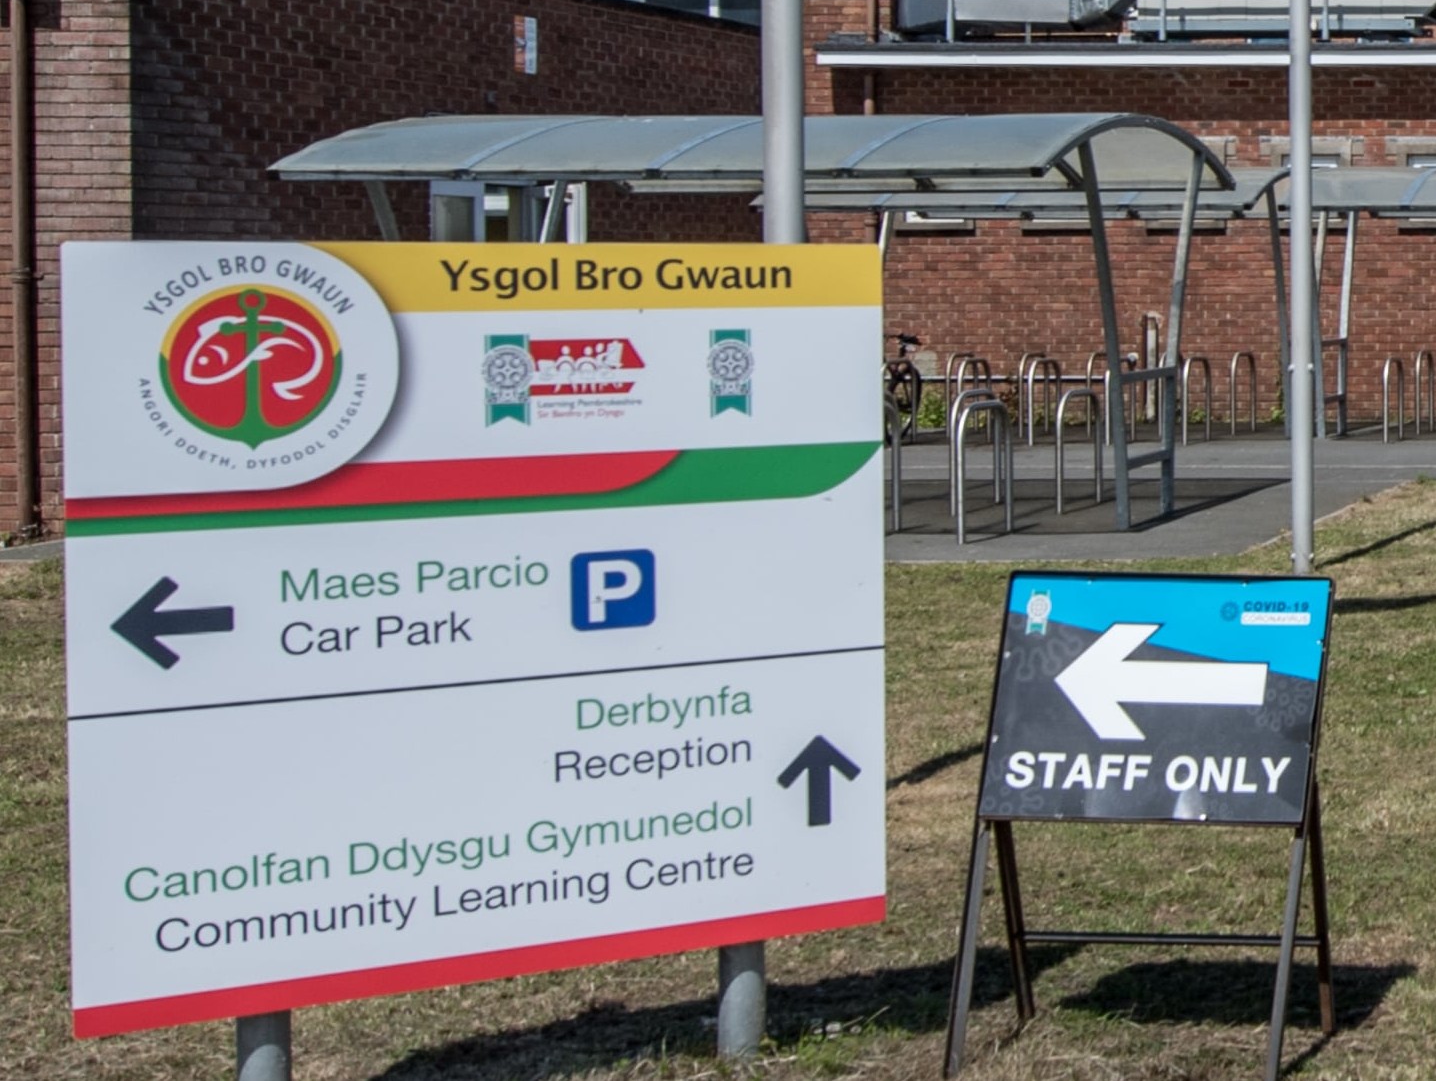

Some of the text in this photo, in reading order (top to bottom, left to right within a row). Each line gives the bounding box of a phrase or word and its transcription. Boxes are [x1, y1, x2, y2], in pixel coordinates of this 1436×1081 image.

[143, 255, 355, 316] YSGOL BRO GWAUN
[441, 258, 792, 299] Ysgol Bro Gwaun
[139, 372, 368, 470] ANGORI DOETH, DYFODOL DISGLAIR
[281, 555, 549, 603] Maes Parcio
[588, 560, 642, 623] P
[1243, 601, 1309, 612] COVID-19
[281, 611, 472, 656] Car Park
[577, 686, 752, 731] Derbynfa
[555, 737, 752, 782] Reception
[1005, 751, 1291, 793] STAFF ONLY
[124, 797, 753, 903] Canolfan Ddysgu Gymunedol
[155, 852, 754, 953] Community Learning Centre
